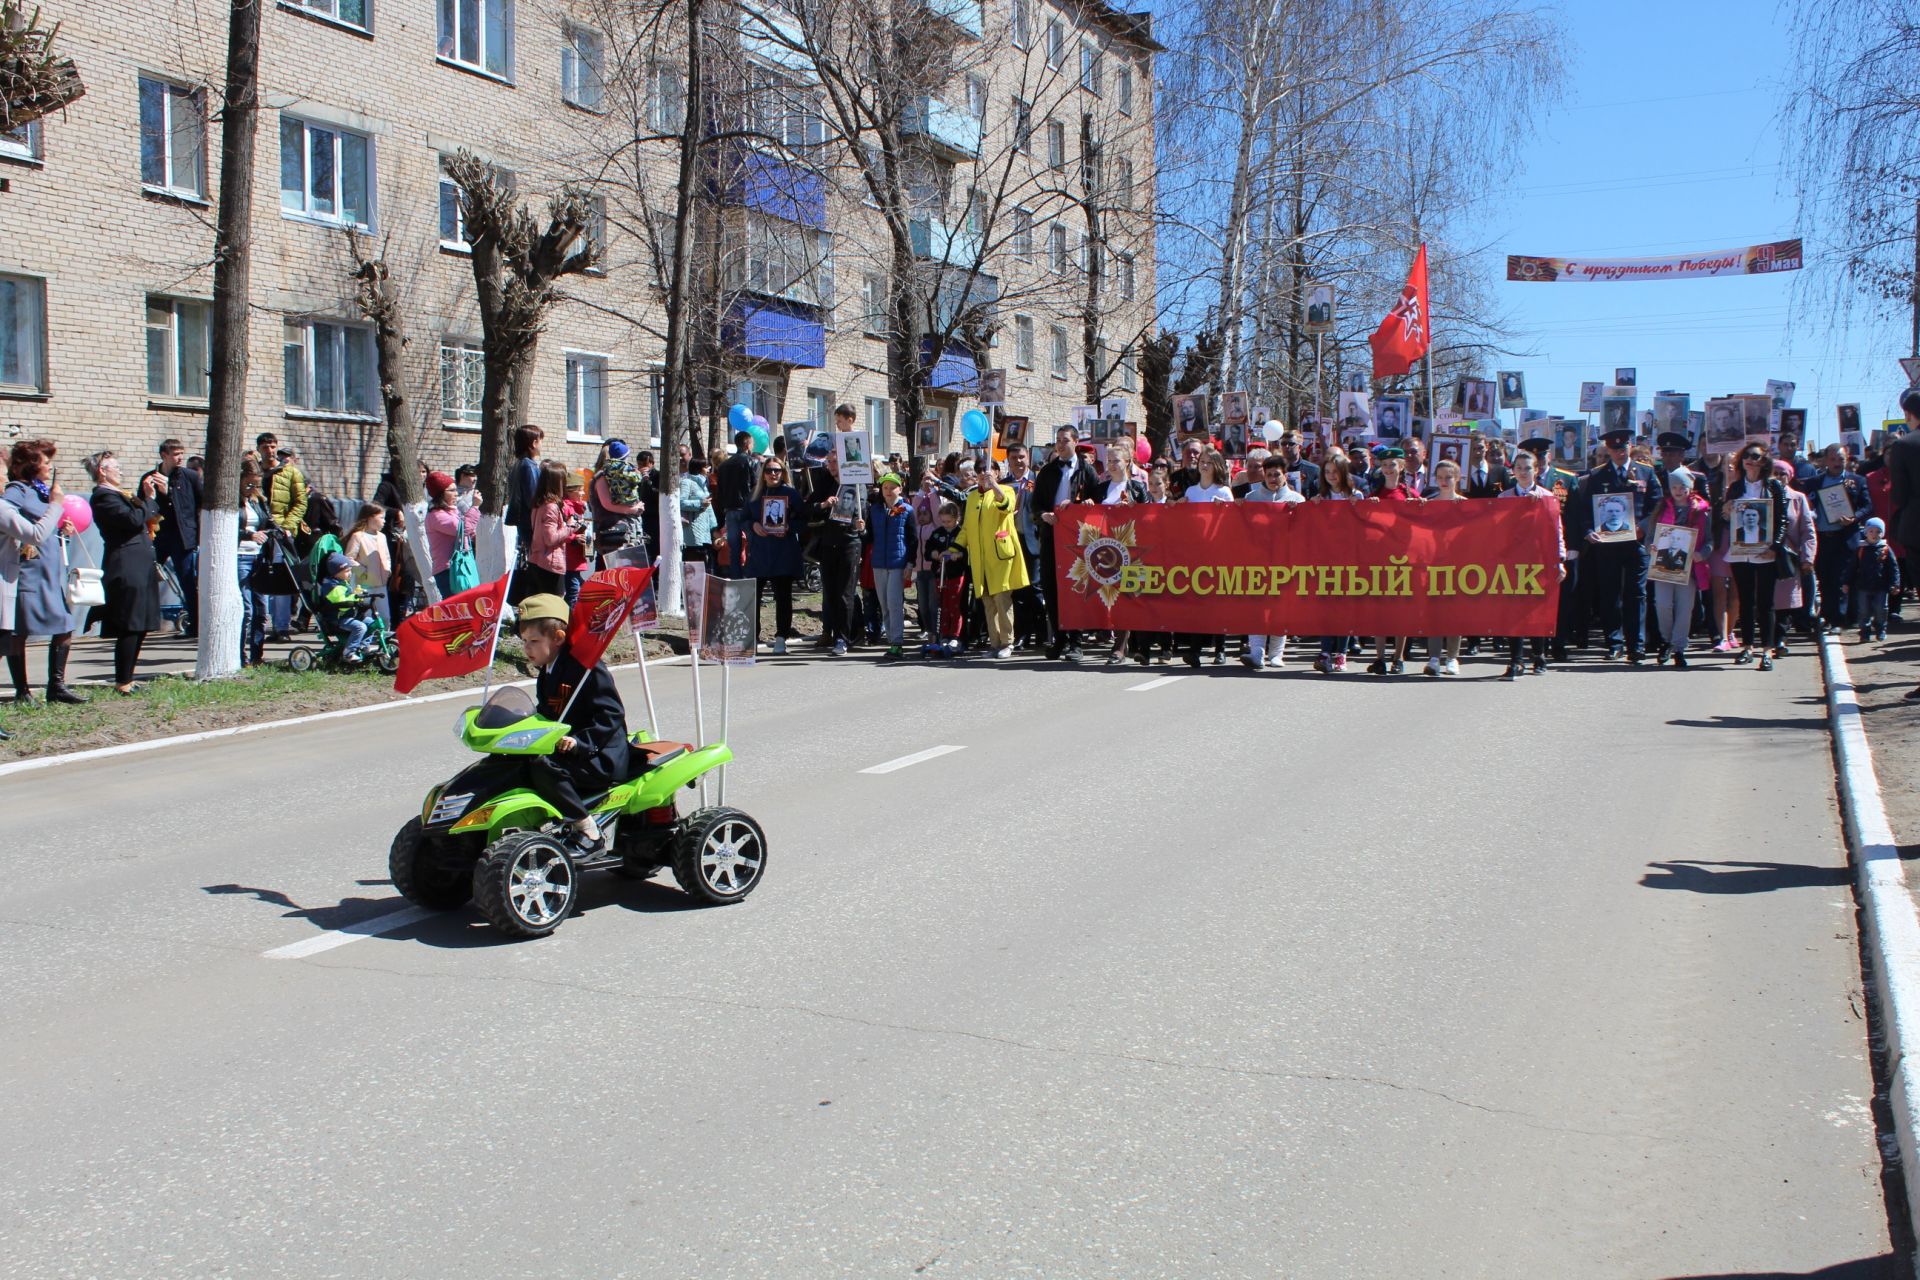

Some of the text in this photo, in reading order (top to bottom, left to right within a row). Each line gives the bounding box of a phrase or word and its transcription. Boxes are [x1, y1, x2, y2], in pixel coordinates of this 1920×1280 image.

[1565, 254, 1742, 281] С праздником Победы!
[1757, 246, 1799, 272] 9 мая
[1120, 555, 1546, 596] БЕССМЕРТНЫЙ ПОЛК
